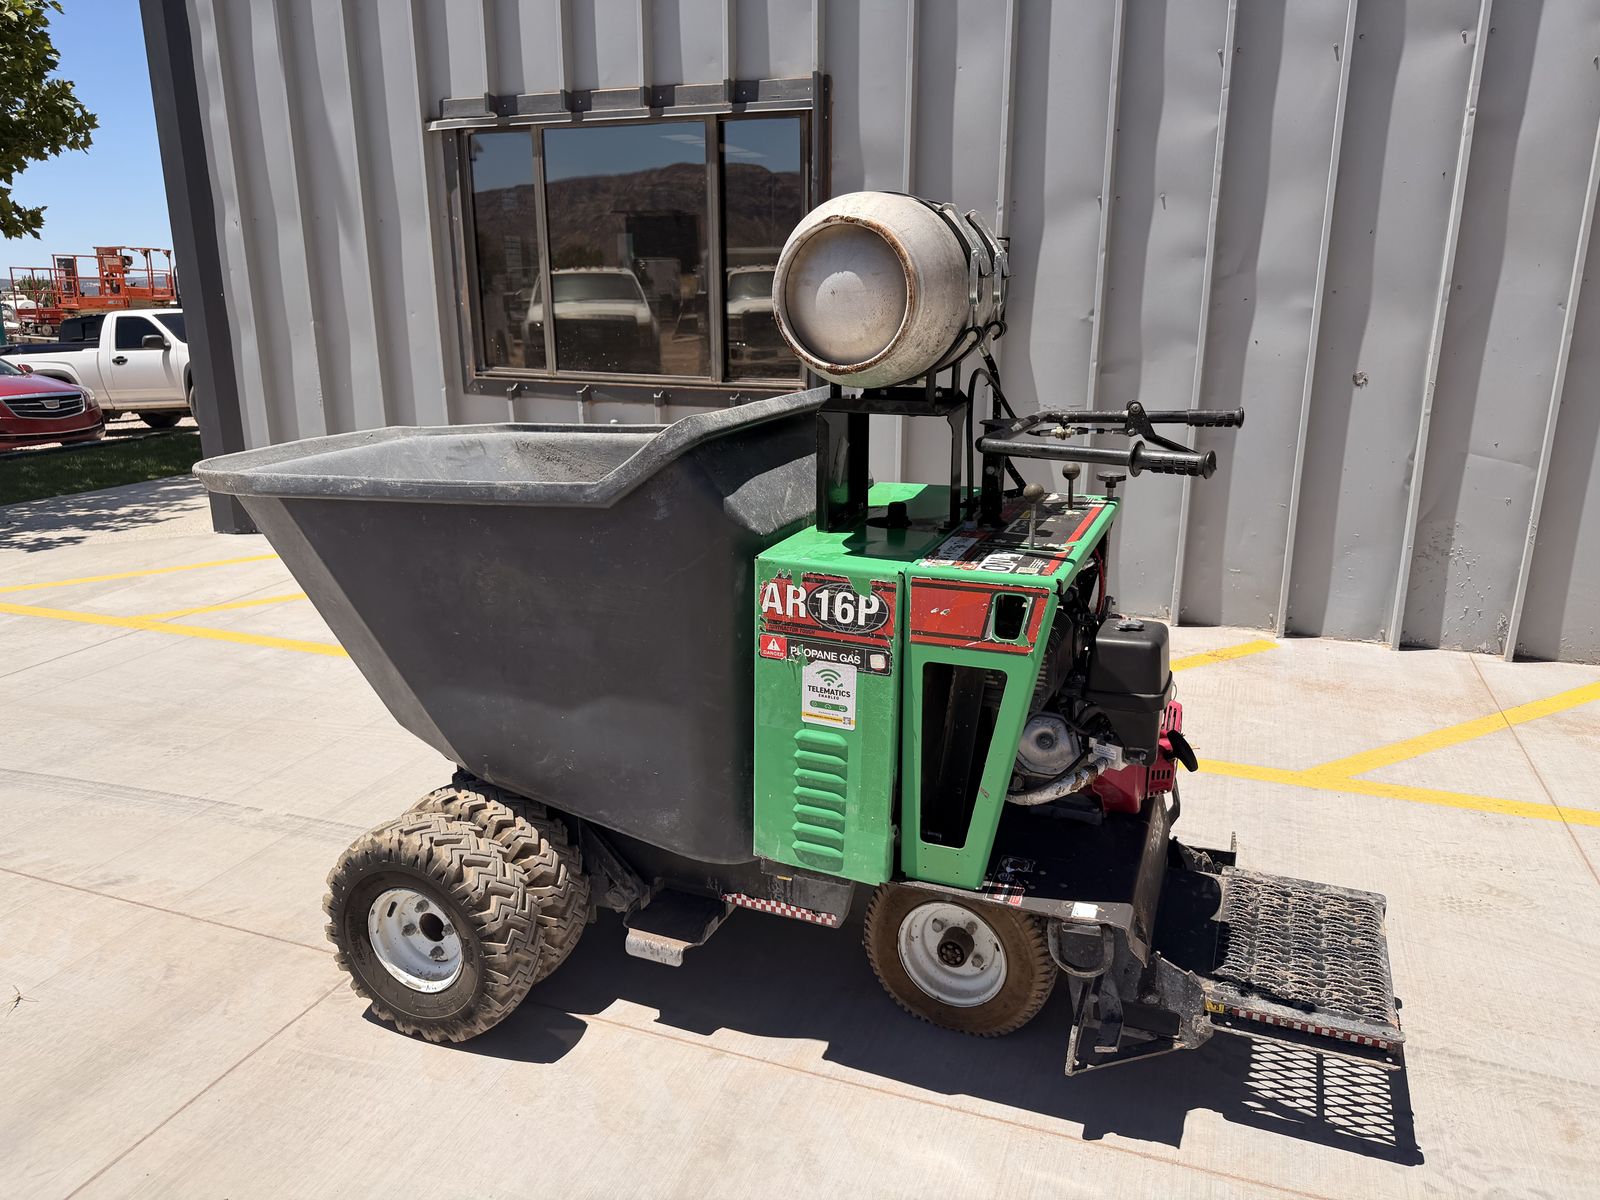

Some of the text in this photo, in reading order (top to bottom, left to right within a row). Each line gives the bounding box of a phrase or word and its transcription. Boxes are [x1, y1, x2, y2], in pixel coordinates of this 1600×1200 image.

[762, 582, 880, 626] AR 16P
[790, 645, 861, 665] POPANE GAS
[807, 685, 851, 698] TELEMATICS
